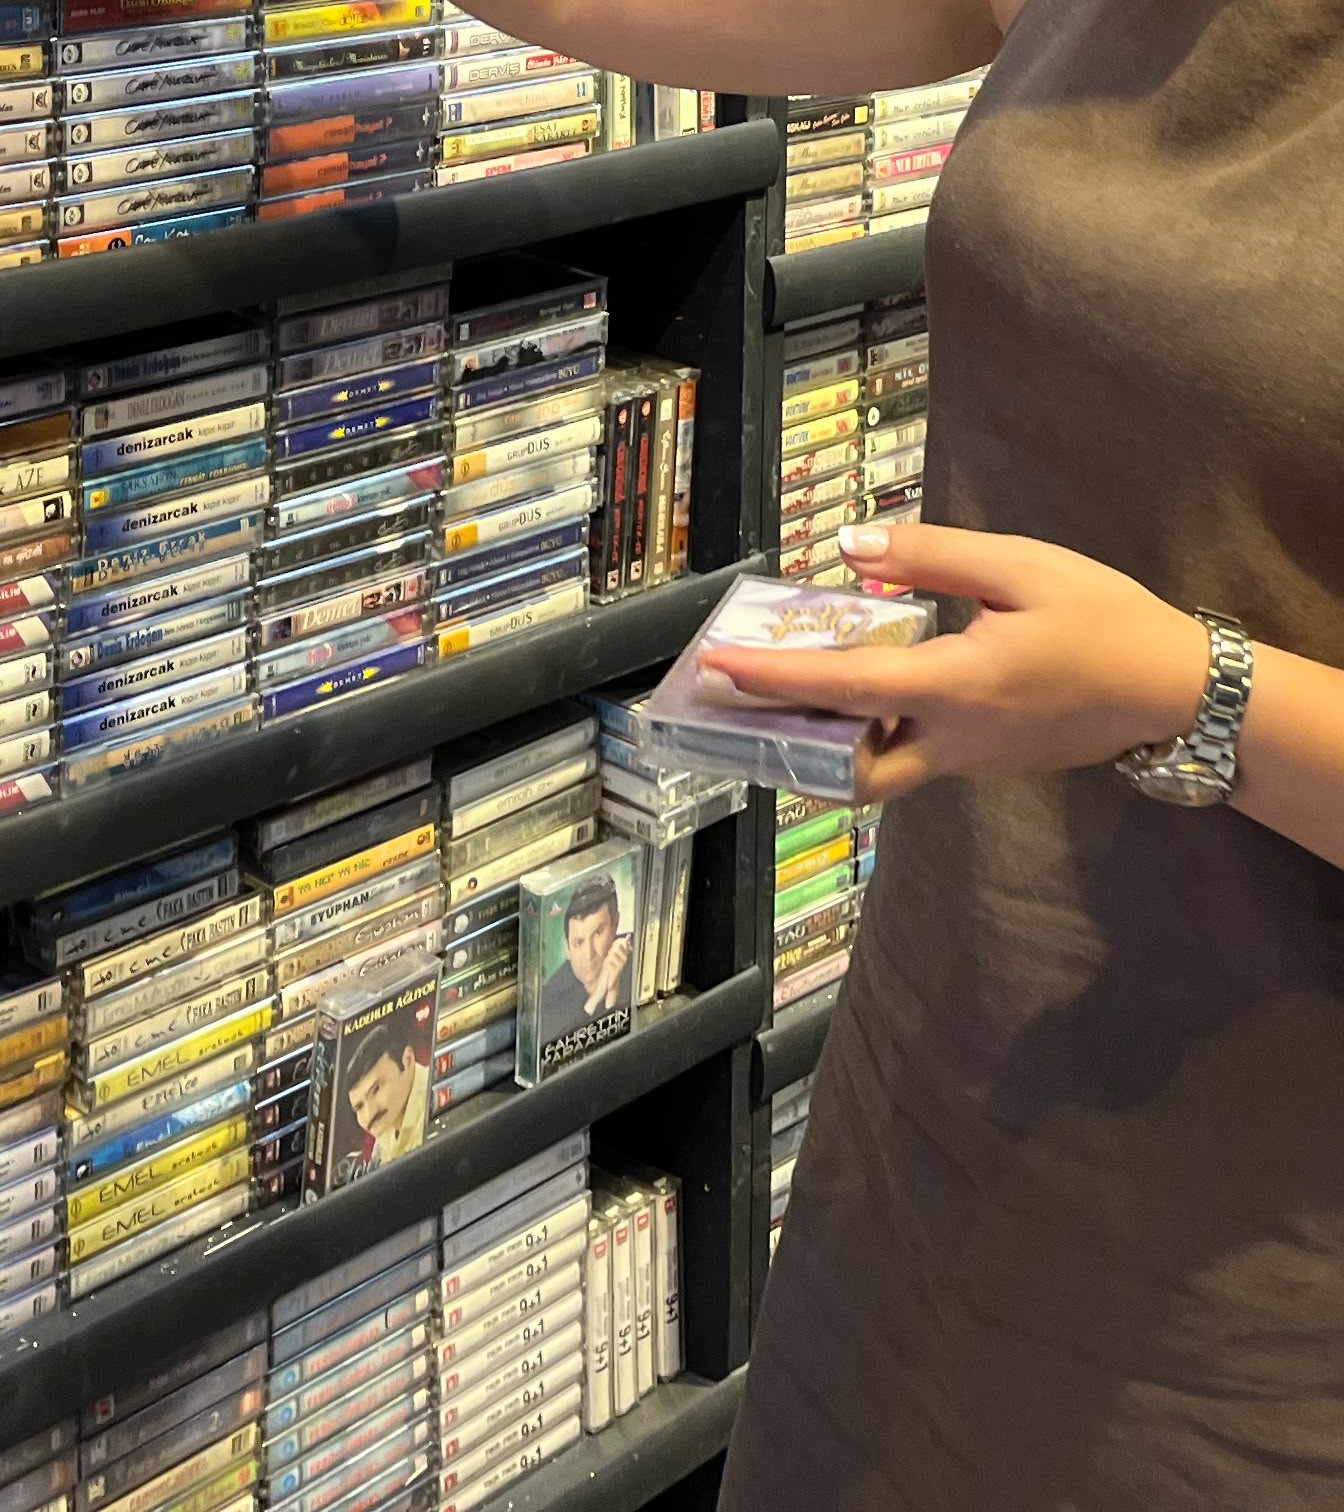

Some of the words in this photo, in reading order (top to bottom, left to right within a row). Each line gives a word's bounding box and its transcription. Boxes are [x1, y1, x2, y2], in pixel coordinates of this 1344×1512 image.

[116, 426, 194, 458] denizarcak
[122, 502, 199, 533] denizarcak
[101, 584, 179, 617] denizarcak
[126, 1048, 191, 1090] EMEL
[98, 1160, 160, 1203] EMEL
